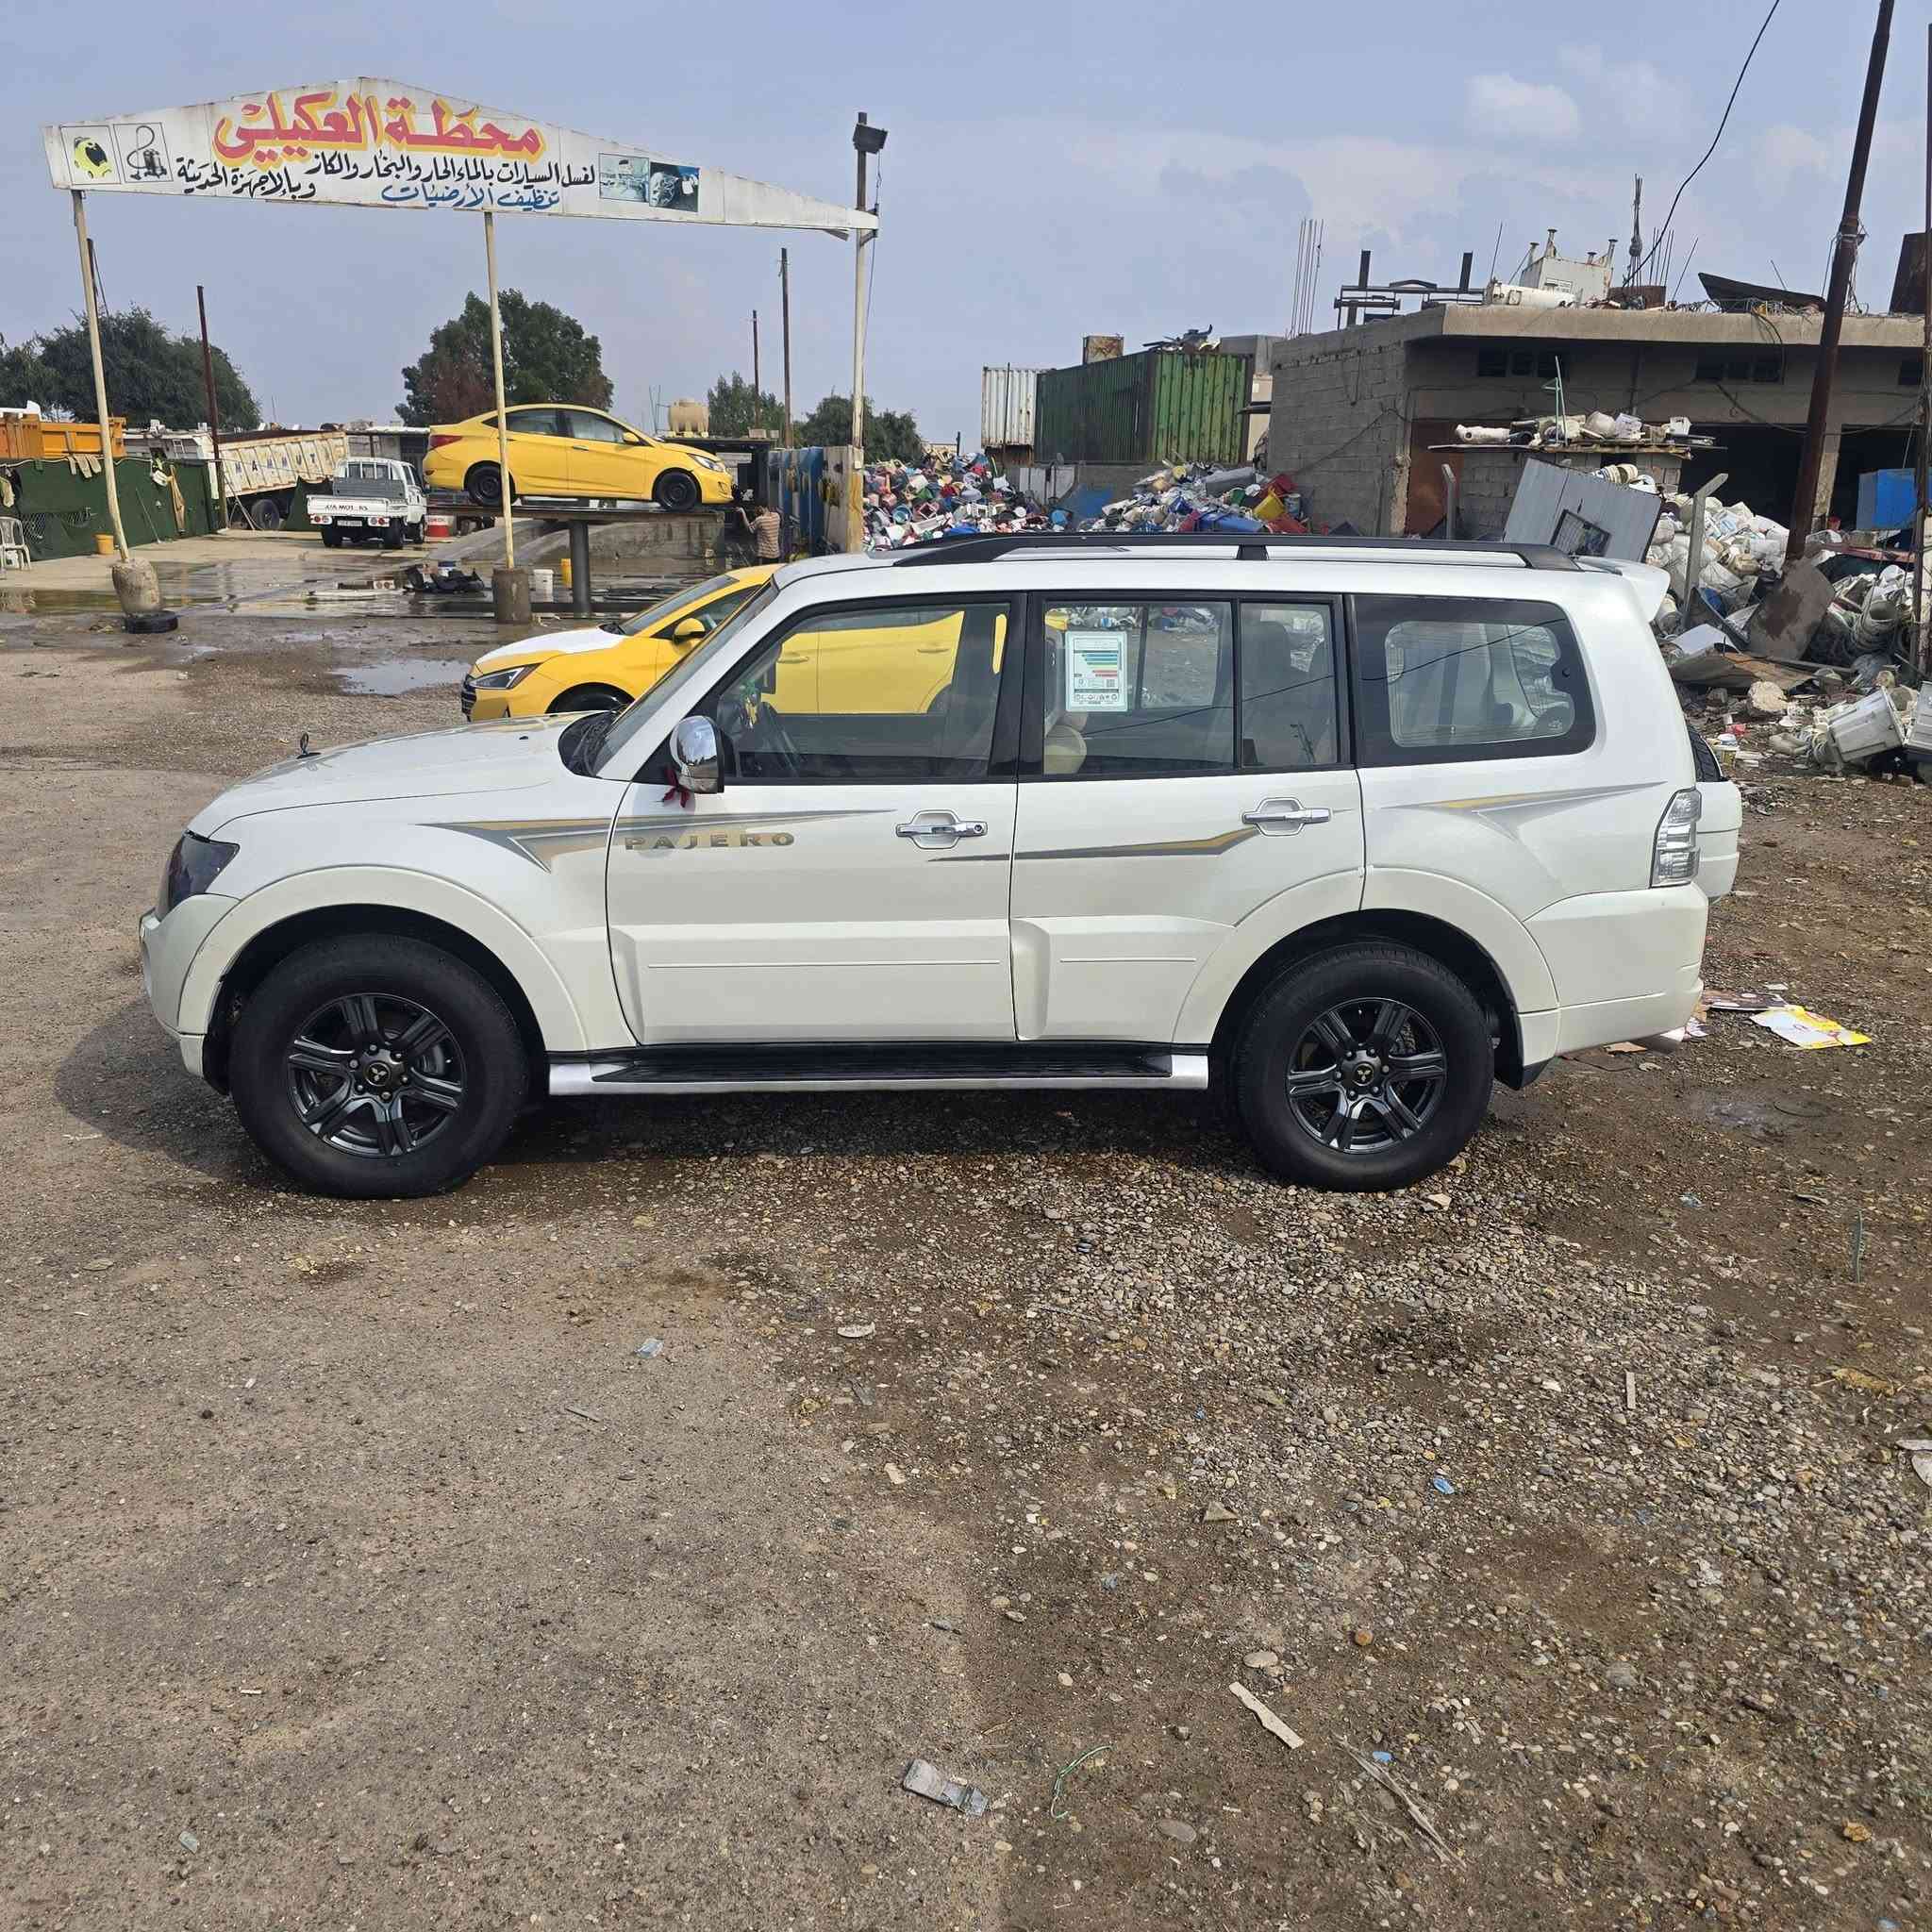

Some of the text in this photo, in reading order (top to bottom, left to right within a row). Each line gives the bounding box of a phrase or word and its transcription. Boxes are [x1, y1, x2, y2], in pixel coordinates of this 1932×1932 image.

[384, 97, 545, 160] محطة
[175, 157, 228, 193] الحديثة
[304, 150, 596, 189] لغسل السيارات بالماء الحار والبخار والكاز
[496, 189, 560, 211] تنظيف
[625, 832, 795, 851] PAJERO
